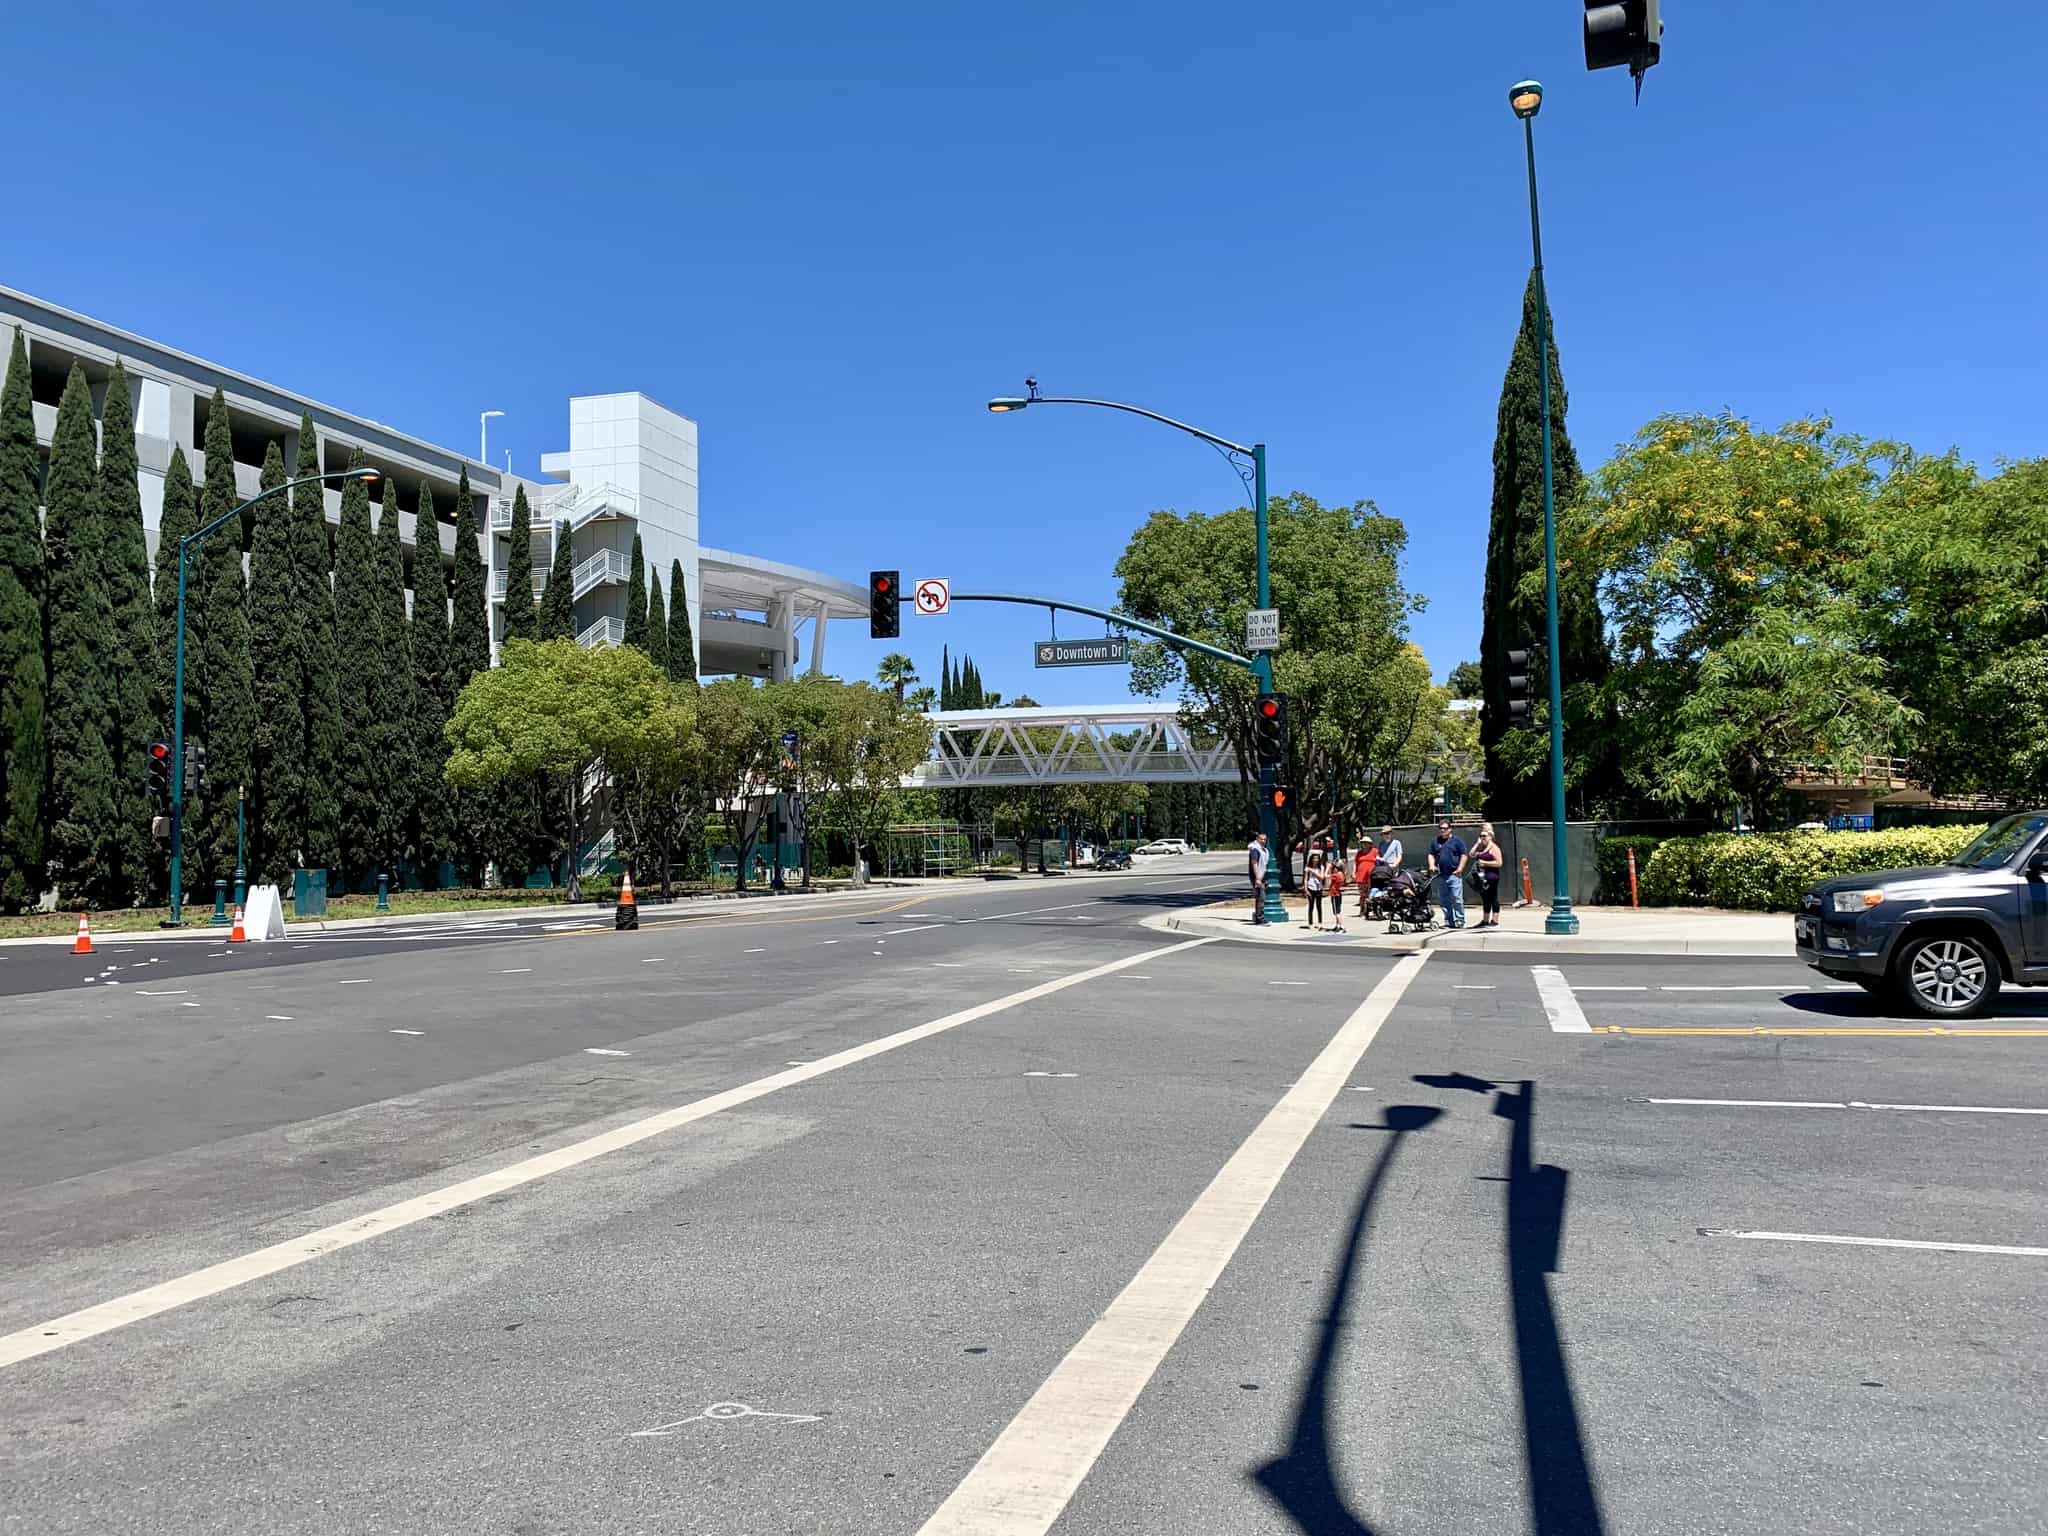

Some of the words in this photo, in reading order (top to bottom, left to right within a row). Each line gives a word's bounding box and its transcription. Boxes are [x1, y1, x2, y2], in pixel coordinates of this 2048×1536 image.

[1248, 615, 1258, 625] DO
[1262, 614, 1277, 624] NOT
[1248, 627, 1277, 637] BLOCK
[1056, 645, 1108, 660] Downtown
[1111, 644, 1123, 657] Dr
